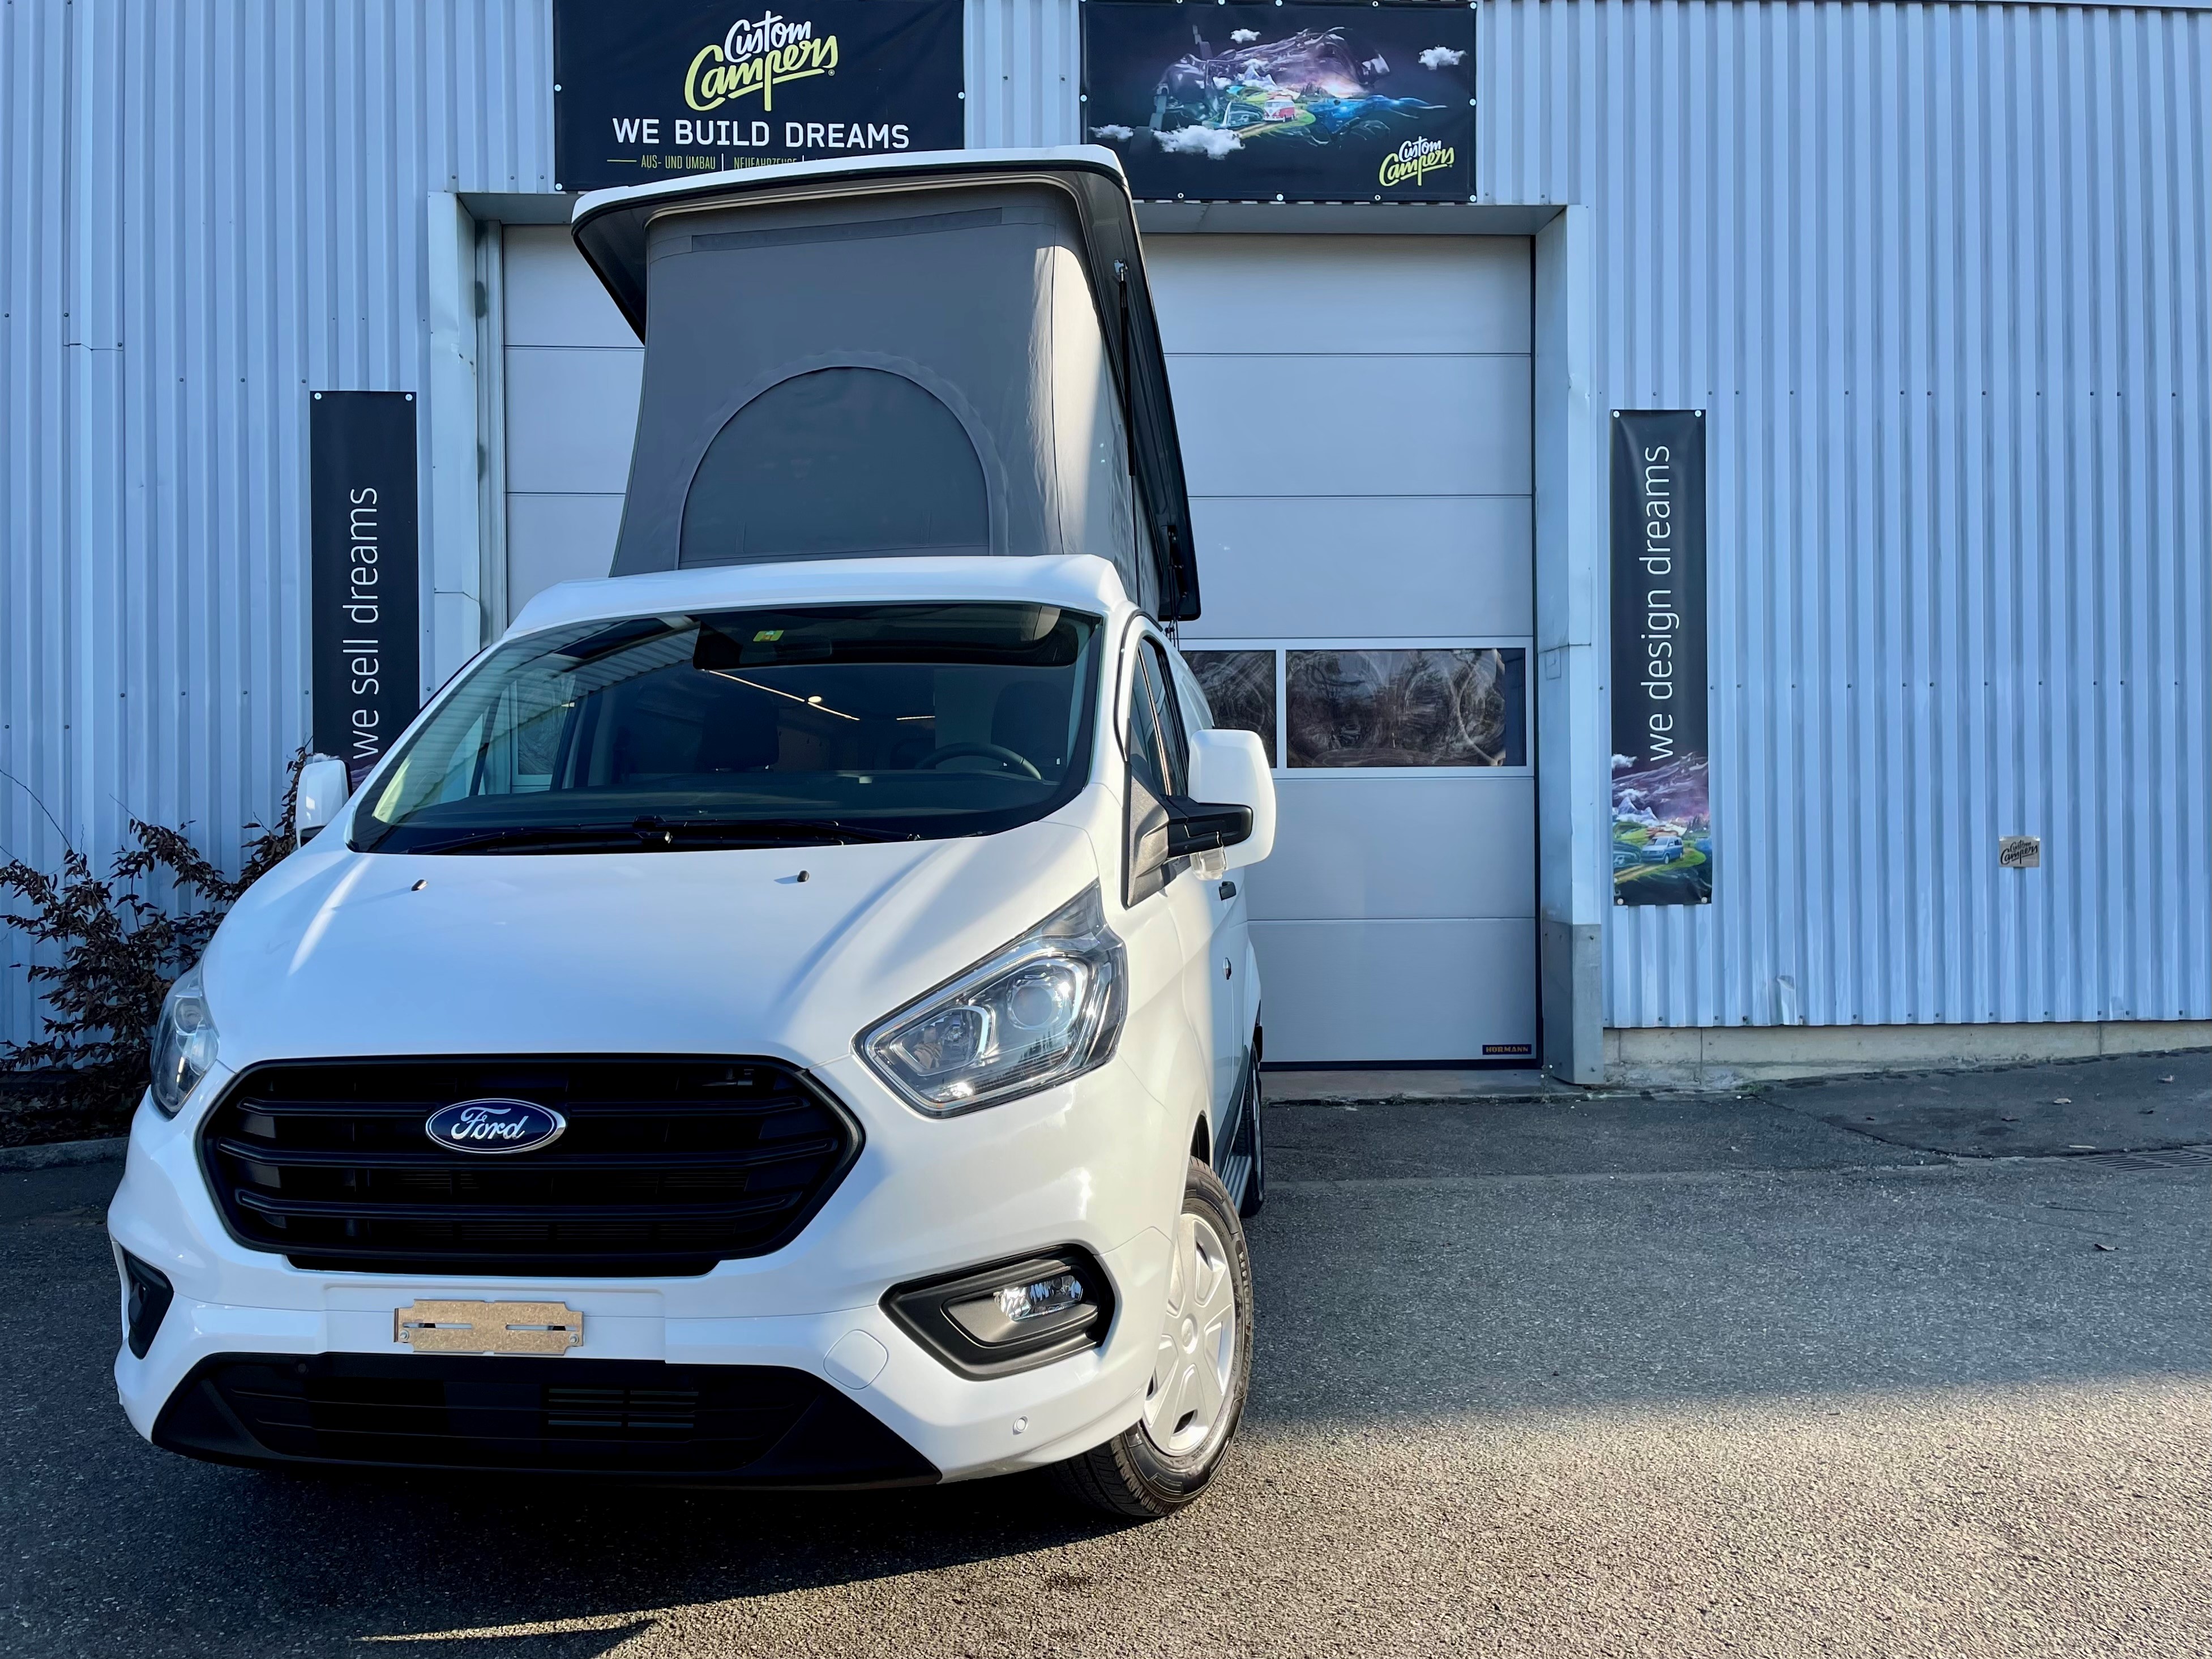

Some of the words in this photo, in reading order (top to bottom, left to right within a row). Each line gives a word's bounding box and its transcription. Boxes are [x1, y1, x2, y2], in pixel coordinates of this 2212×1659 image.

[724, 10, 811, 63] Custom
[684, 35, 838, 112] Campers
[612, 117, 660, 145] WE
[674, 119, 770, 147] BUILD
[785, 122, 910, 149] DREAMS
[1398, 135, 1442, 163] Custom
[641, 154, 662, 169] AUS-
[665, 155, 683, 169] UND
[685, 155, 716, 170] UMBAU
[1379, 147, 1455, 187] Campers
[1639, 445, 1671, 575] dreams
[342, 486, 379, 623] dreams
[342, 639, 379, 695] sell
[1640, 588, 1679, 700] design
[352, 709, 379, 760] we
[1649, 713, 1674, 762] we
[2000, 845, 2038, 865] Campers
[2010, 840, 2031, 852] Custom
[450, 1106, 529, 1140] Ford
